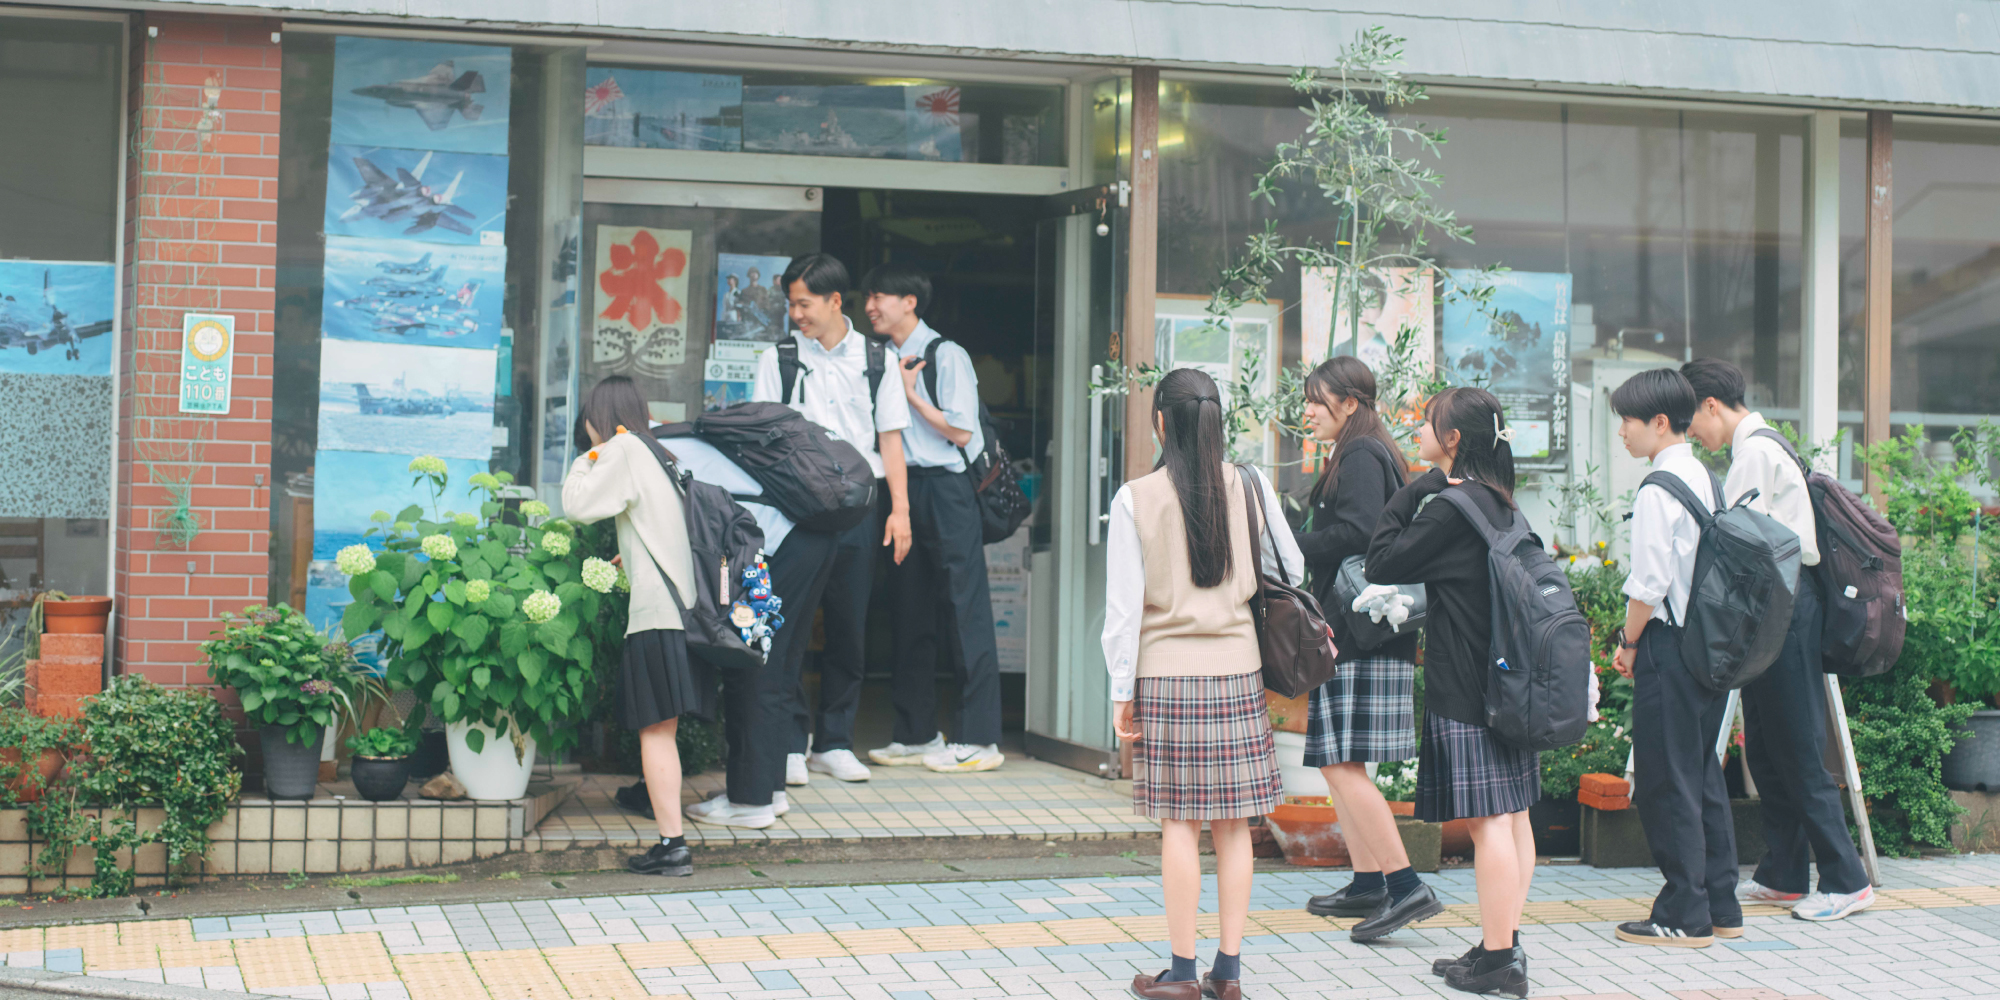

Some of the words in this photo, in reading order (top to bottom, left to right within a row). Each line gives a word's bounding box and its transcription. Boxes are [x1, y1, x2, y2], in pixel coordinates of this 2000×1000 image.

[599, 230, 686, 332] 氷
[1553, 282, 1567, 325] 竹島は
[186, 366, 226, 381] こども
[1553, 331, 1567, 387] 島根の宝
[186, 384, 225, 401] 110番
[1552, 391, 1567, 450] わが領土
